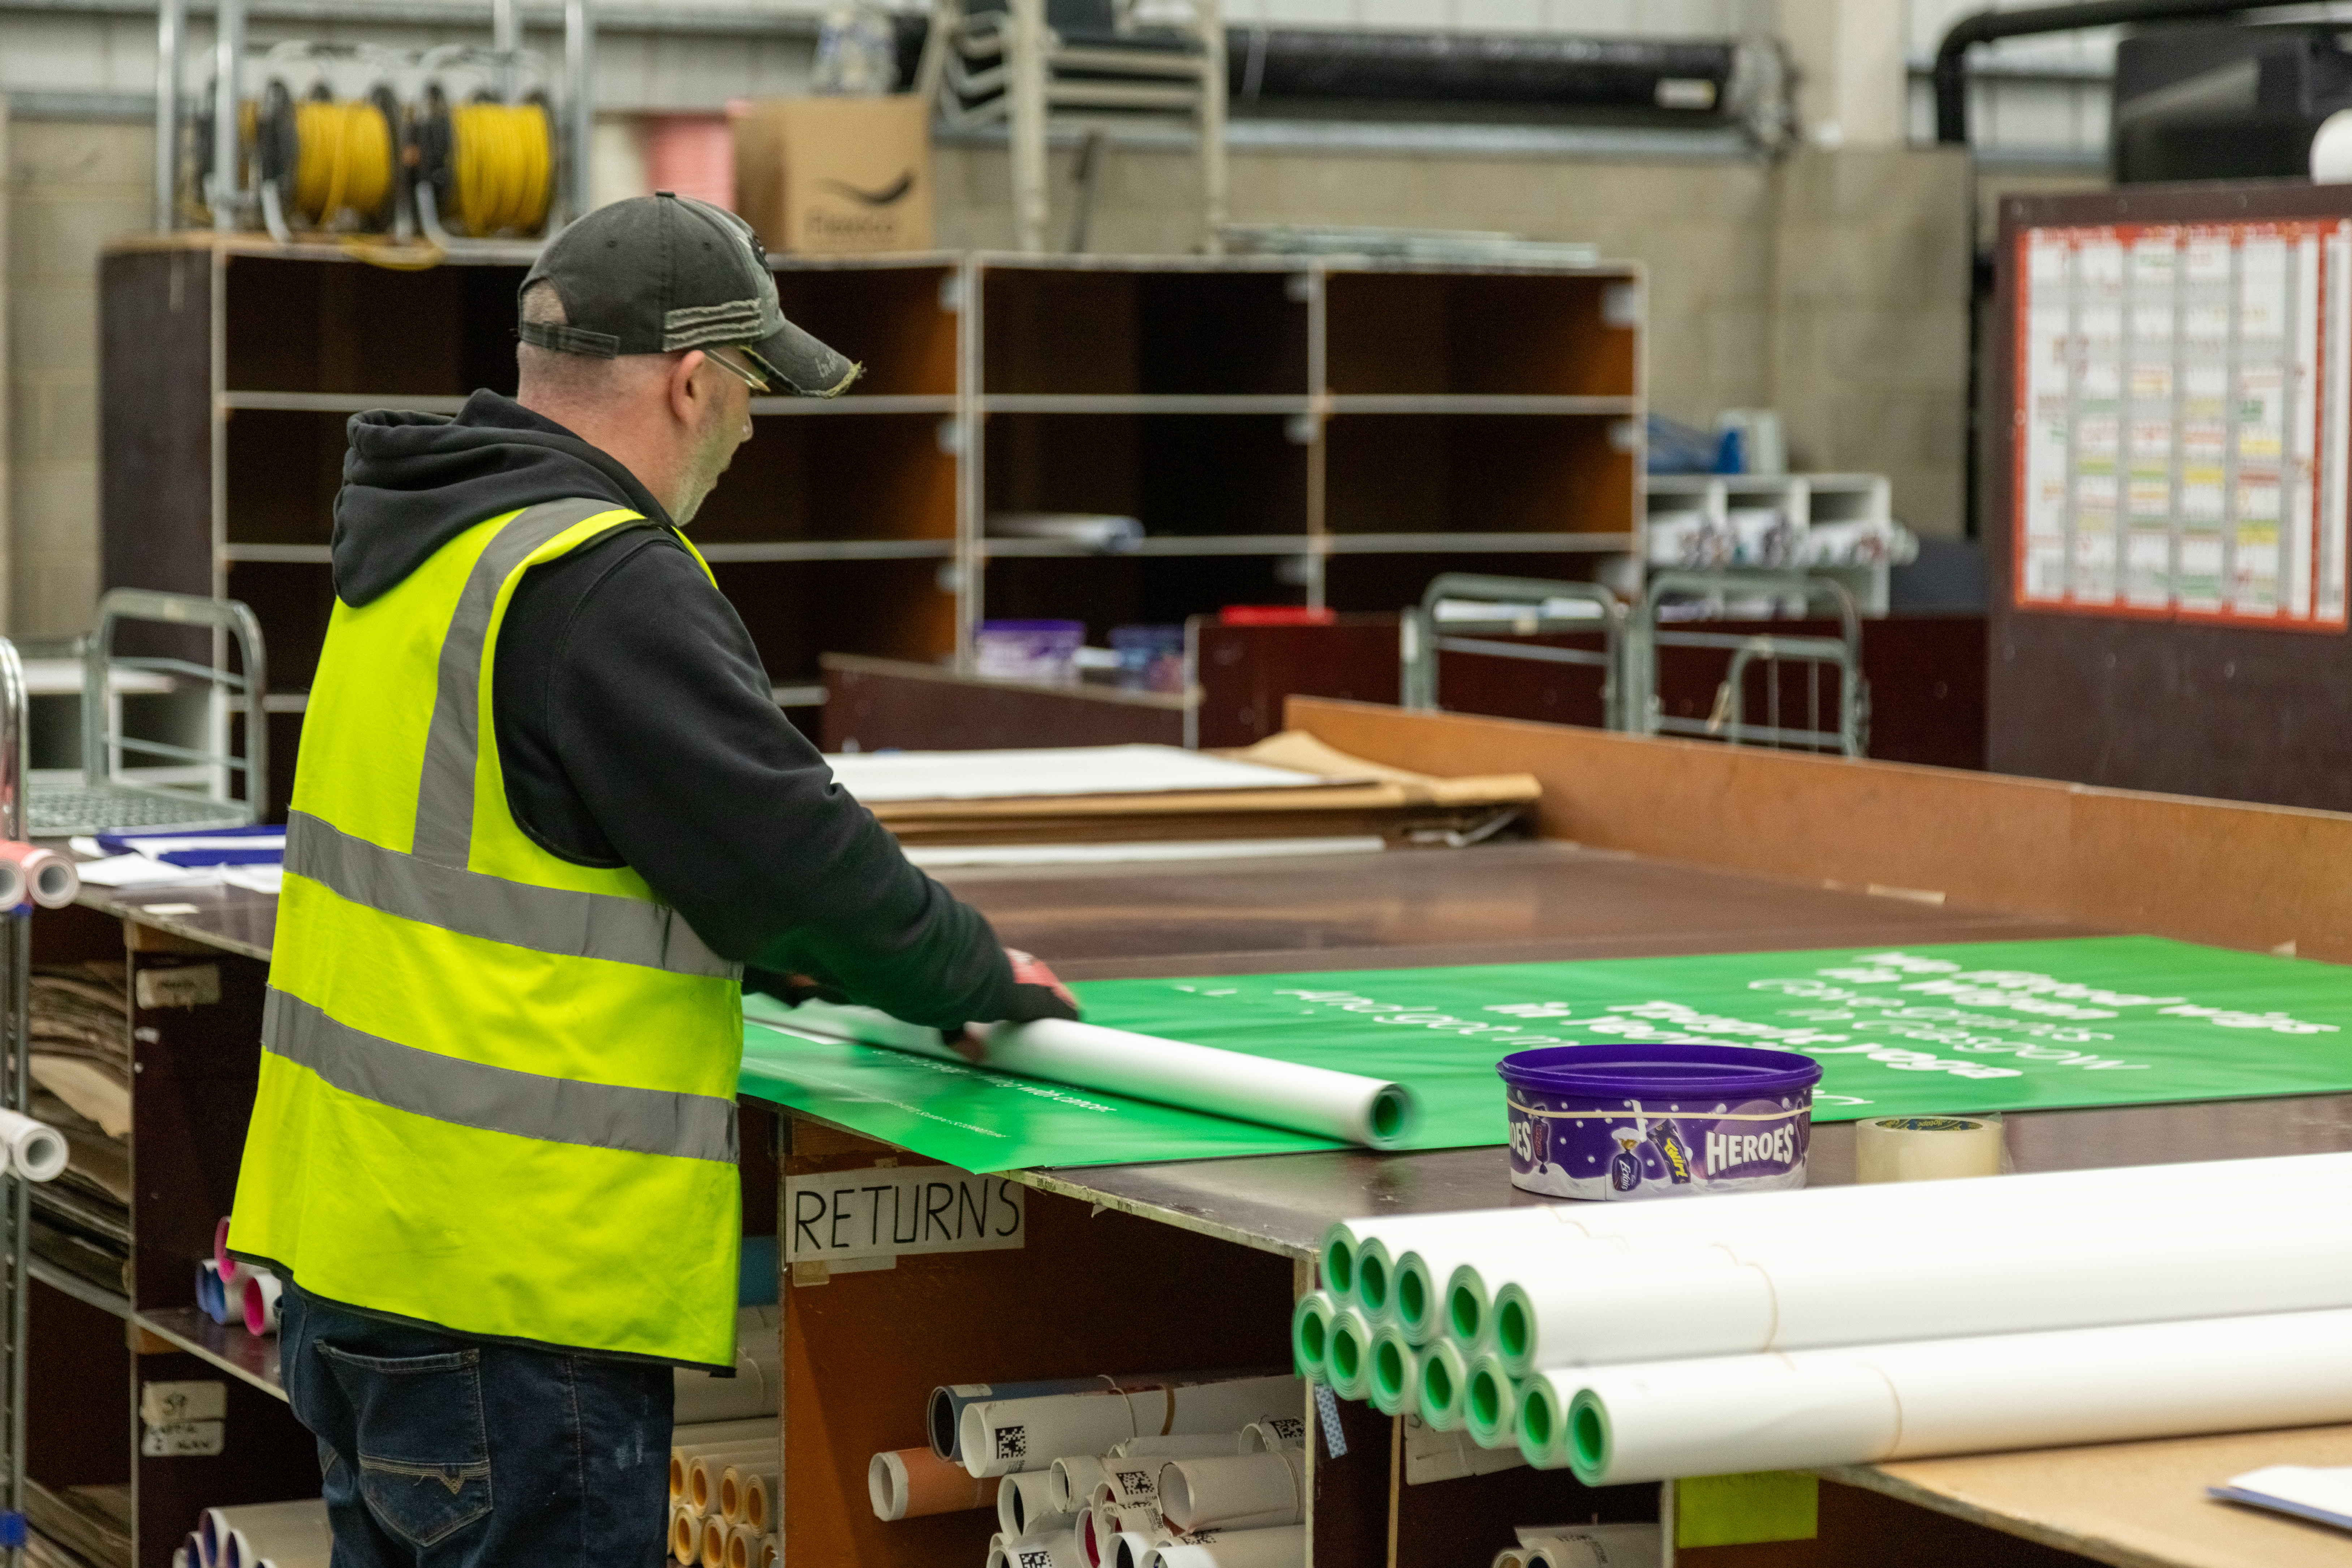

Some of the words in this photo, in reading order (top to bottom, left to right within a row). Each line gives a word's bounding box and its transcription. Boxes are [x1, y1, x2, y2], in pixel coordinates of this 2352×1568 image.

[1018, 1086, 1063, 1097] with
[1052, 1096, 1117, 1112] cancer.
[1707, 1123, 1794, 1176] HEROES
[1619, 1159, 1631, 1190] Eclairs
[795, 1179, 1019, 1253] RETURNS
